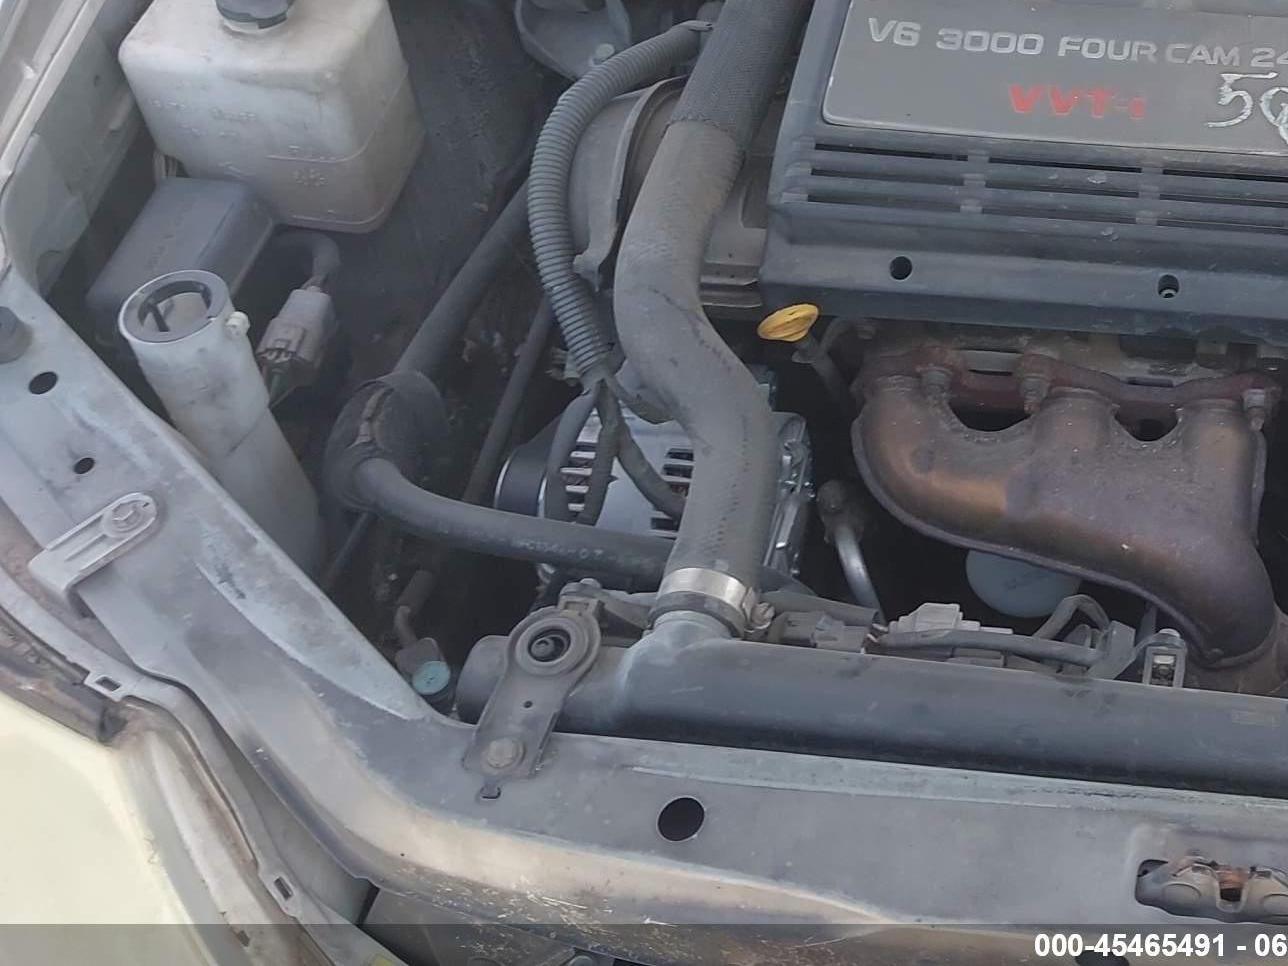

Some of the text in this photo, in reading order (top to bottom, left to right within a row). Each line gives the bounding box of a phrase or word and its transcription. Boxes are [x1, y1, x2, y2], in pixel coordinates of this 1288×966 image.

[868, 17, 921, 47] V6
[936, 27, 1045, 56] 3000
[1057, 36, 1157, 64] FOUR
[1166, 42, 1240, 68] CAM
